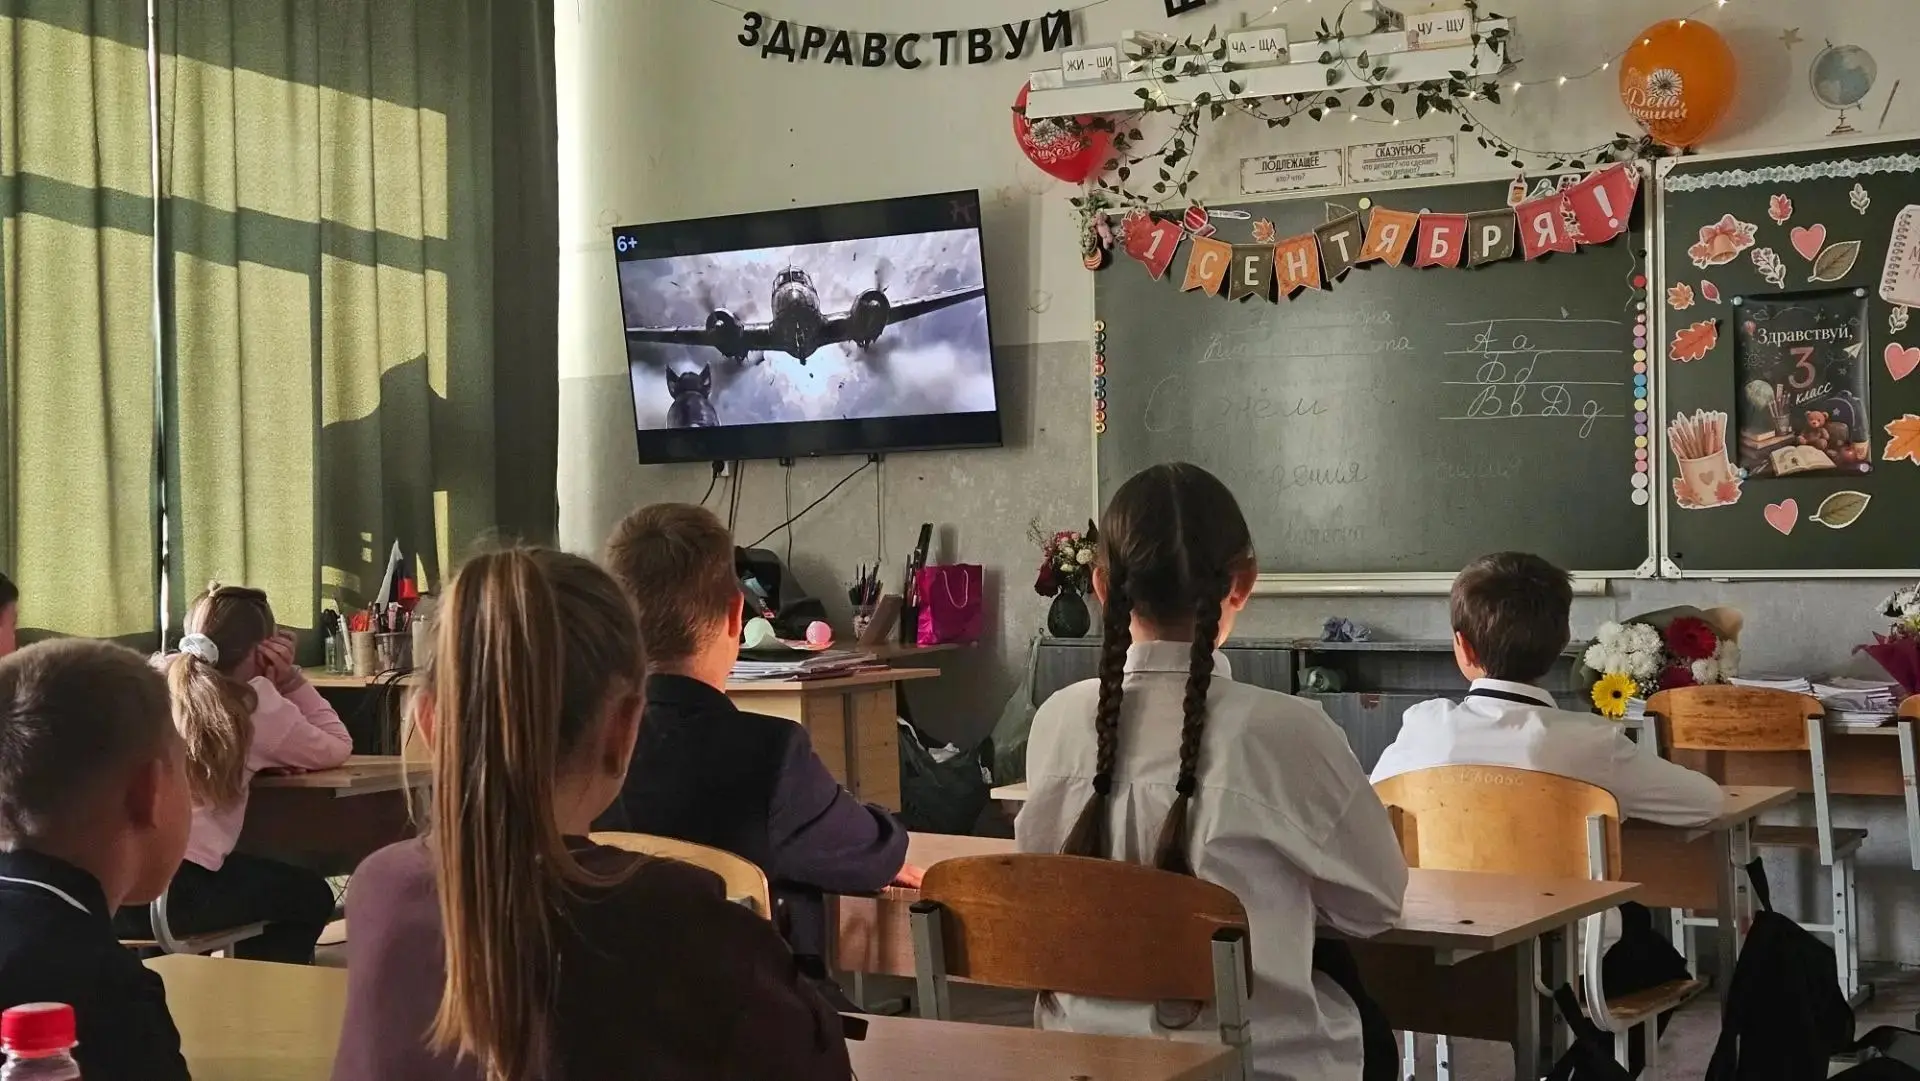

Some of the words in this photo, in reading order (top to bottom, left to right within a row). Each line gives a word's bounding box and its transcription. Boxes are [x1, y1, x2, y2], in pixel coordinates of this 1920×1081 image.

[1417, 21, 1433, 35] ЧУ
[738, 9, 1074, 70] ЗДРАВСТВУЙ
[1232, 41, 1247, 53] ЧА
[1067, 59, 1085, 72] ЖИ
[1096, 56, 1113, 69] ШИ
[1375, 144, 1427, 158] СКАЗУЕМОЕ
[1261, 156, 1320, 172] ПОДЛЕЖАЩЕЕ
[617, 235, 638, 252] 6+
[1142, 228, 1168, 261] 1
[1757, 324, 1853, 347] Здравствуй,
[1787, 346, 1816, 389] 3
[1795, 382, 1833, 406] класс
